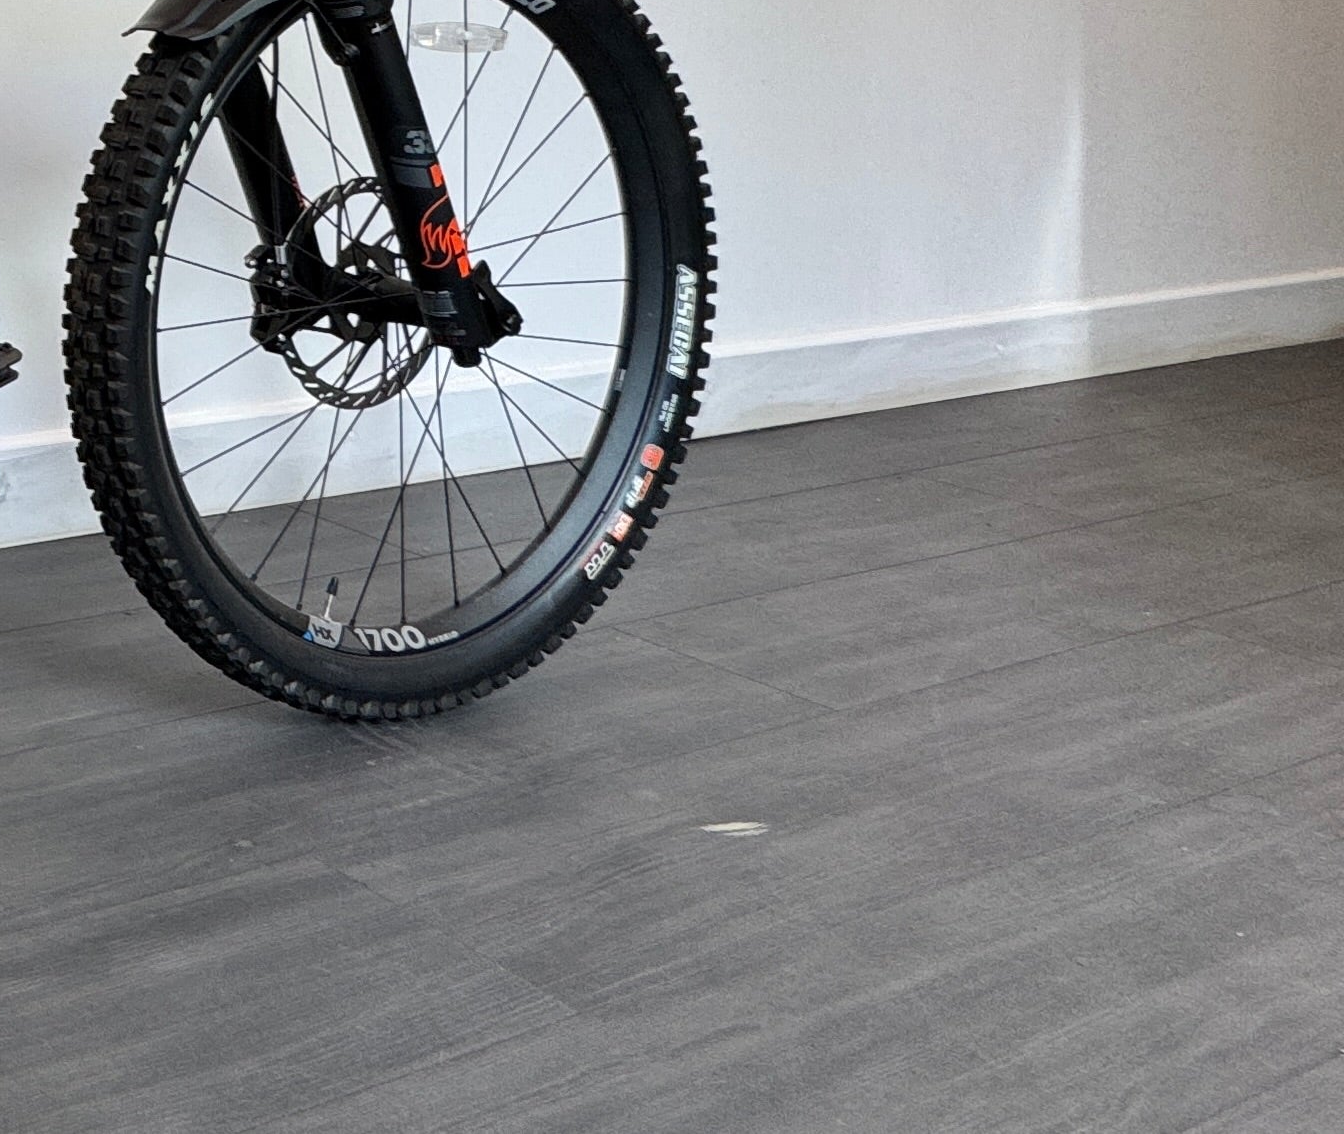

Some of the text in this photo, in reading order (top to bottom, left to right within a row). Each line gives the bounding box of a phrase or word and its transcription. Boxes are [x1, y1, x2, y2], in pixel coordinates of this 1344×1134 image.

[666, 264, 698, 379] ASSEGAI
[311, 622, 336, 643] HX
[354, 624, 426, 653] 1700
